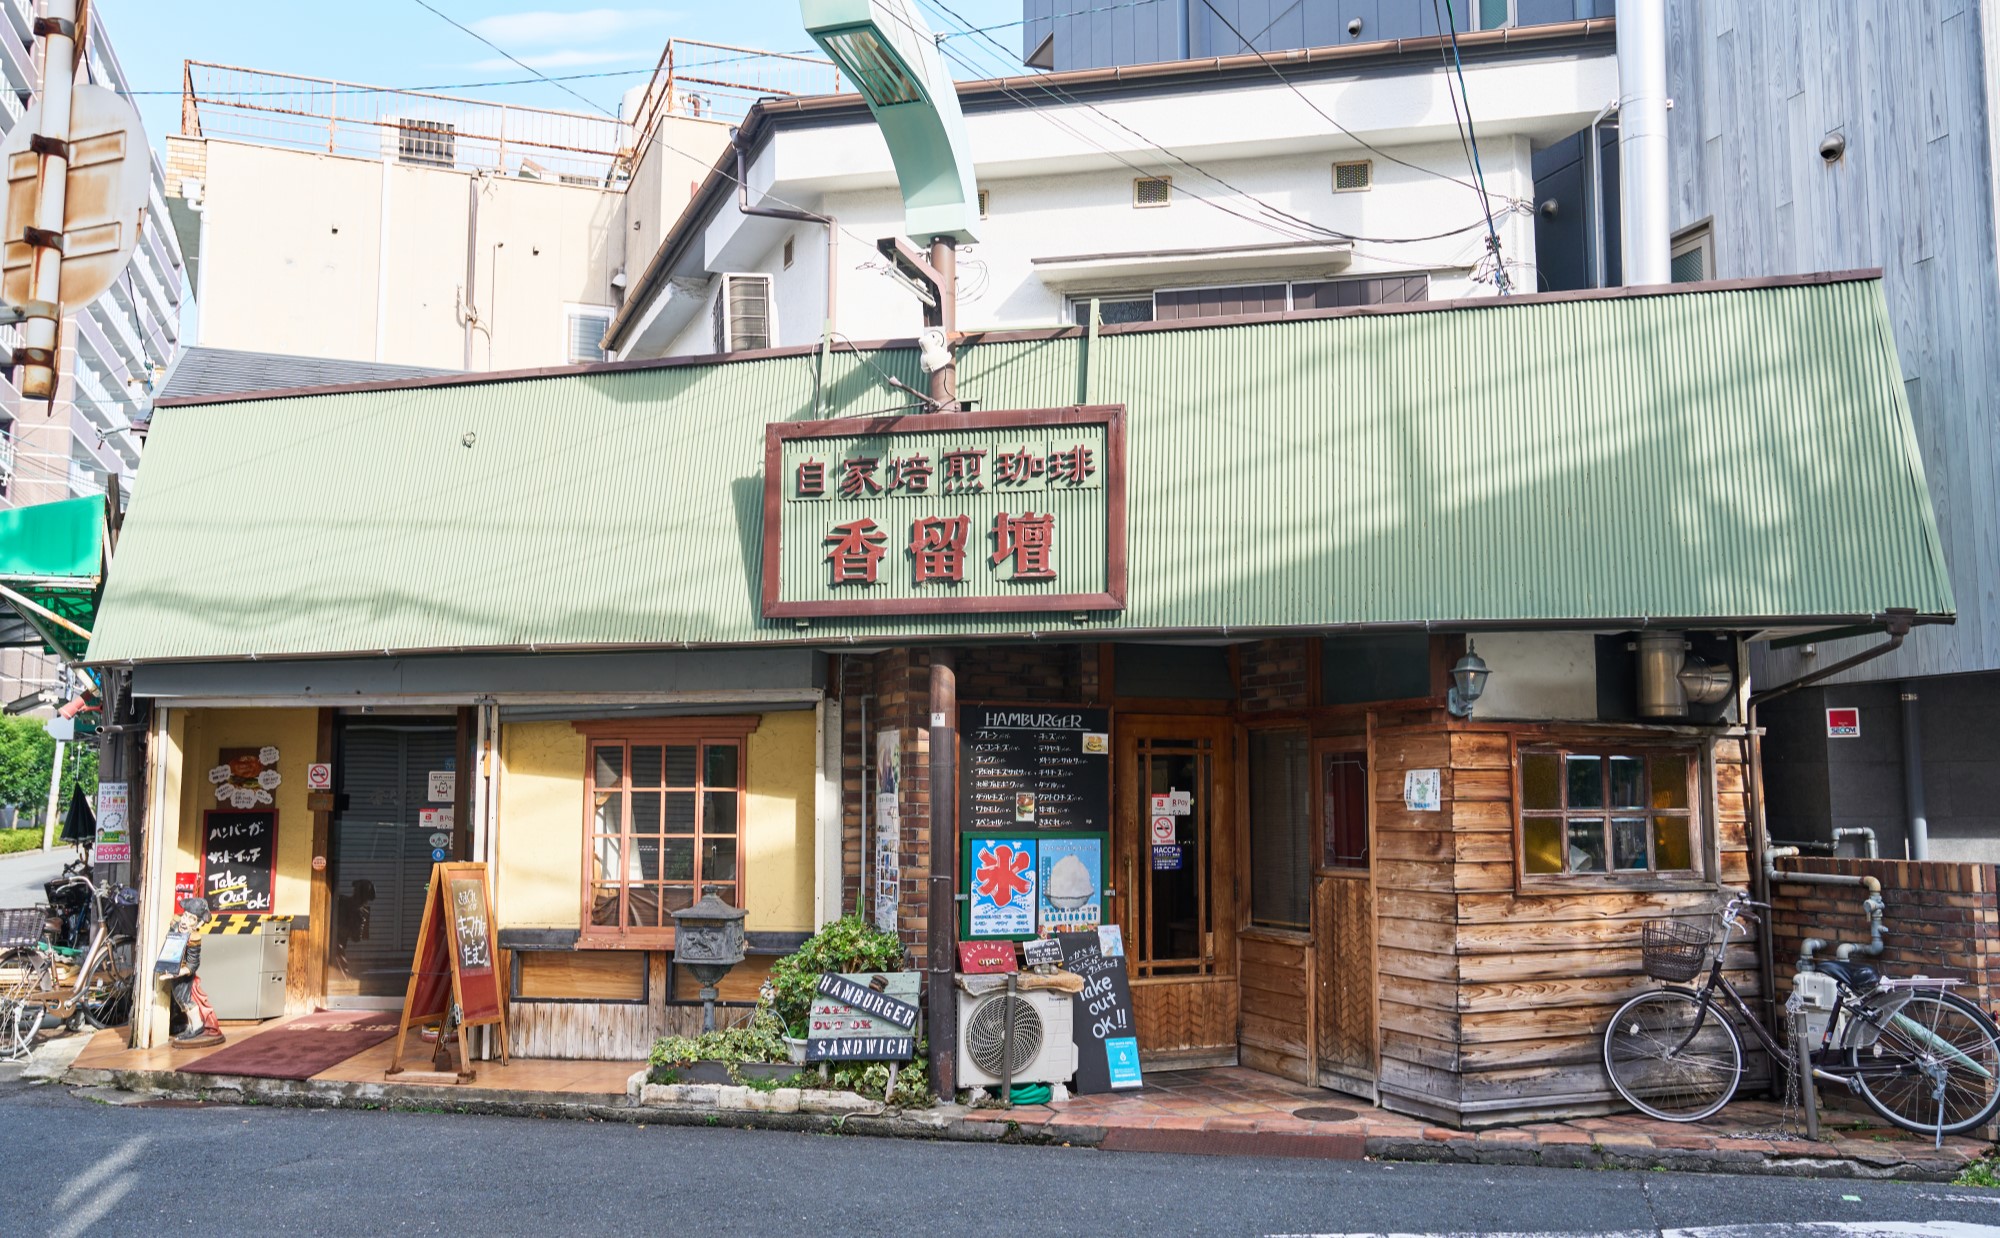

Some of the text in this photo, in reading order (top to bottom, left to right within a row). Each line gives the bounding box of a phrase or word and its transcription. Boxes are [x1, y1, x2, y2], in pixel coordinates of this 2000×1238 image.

[799, 444, 1097, 495] 自家焙煎珈琲
[825, 512, 1057, 583] 香留壇
[985, 712, 1082, 728] HAMBURGER
[209, 821, 264, 840] ハンバーガー
[208, 869, 247, 890] Take
[976, 845, 1030, 907] 氷
[219, 887, 253, 904] Out
[247, 892, 270, 909] ok!
[978, 957, 1004, 966] open
[814, 1005, 852, 1014] TAKE
[819, 975, 915, 1026] HAMBURGER
[1089, 991, 1116, 1016] out
[812, 1020, 872, 1031] OUT OK
[817, 1039, 908, 1055] SANDWICH
